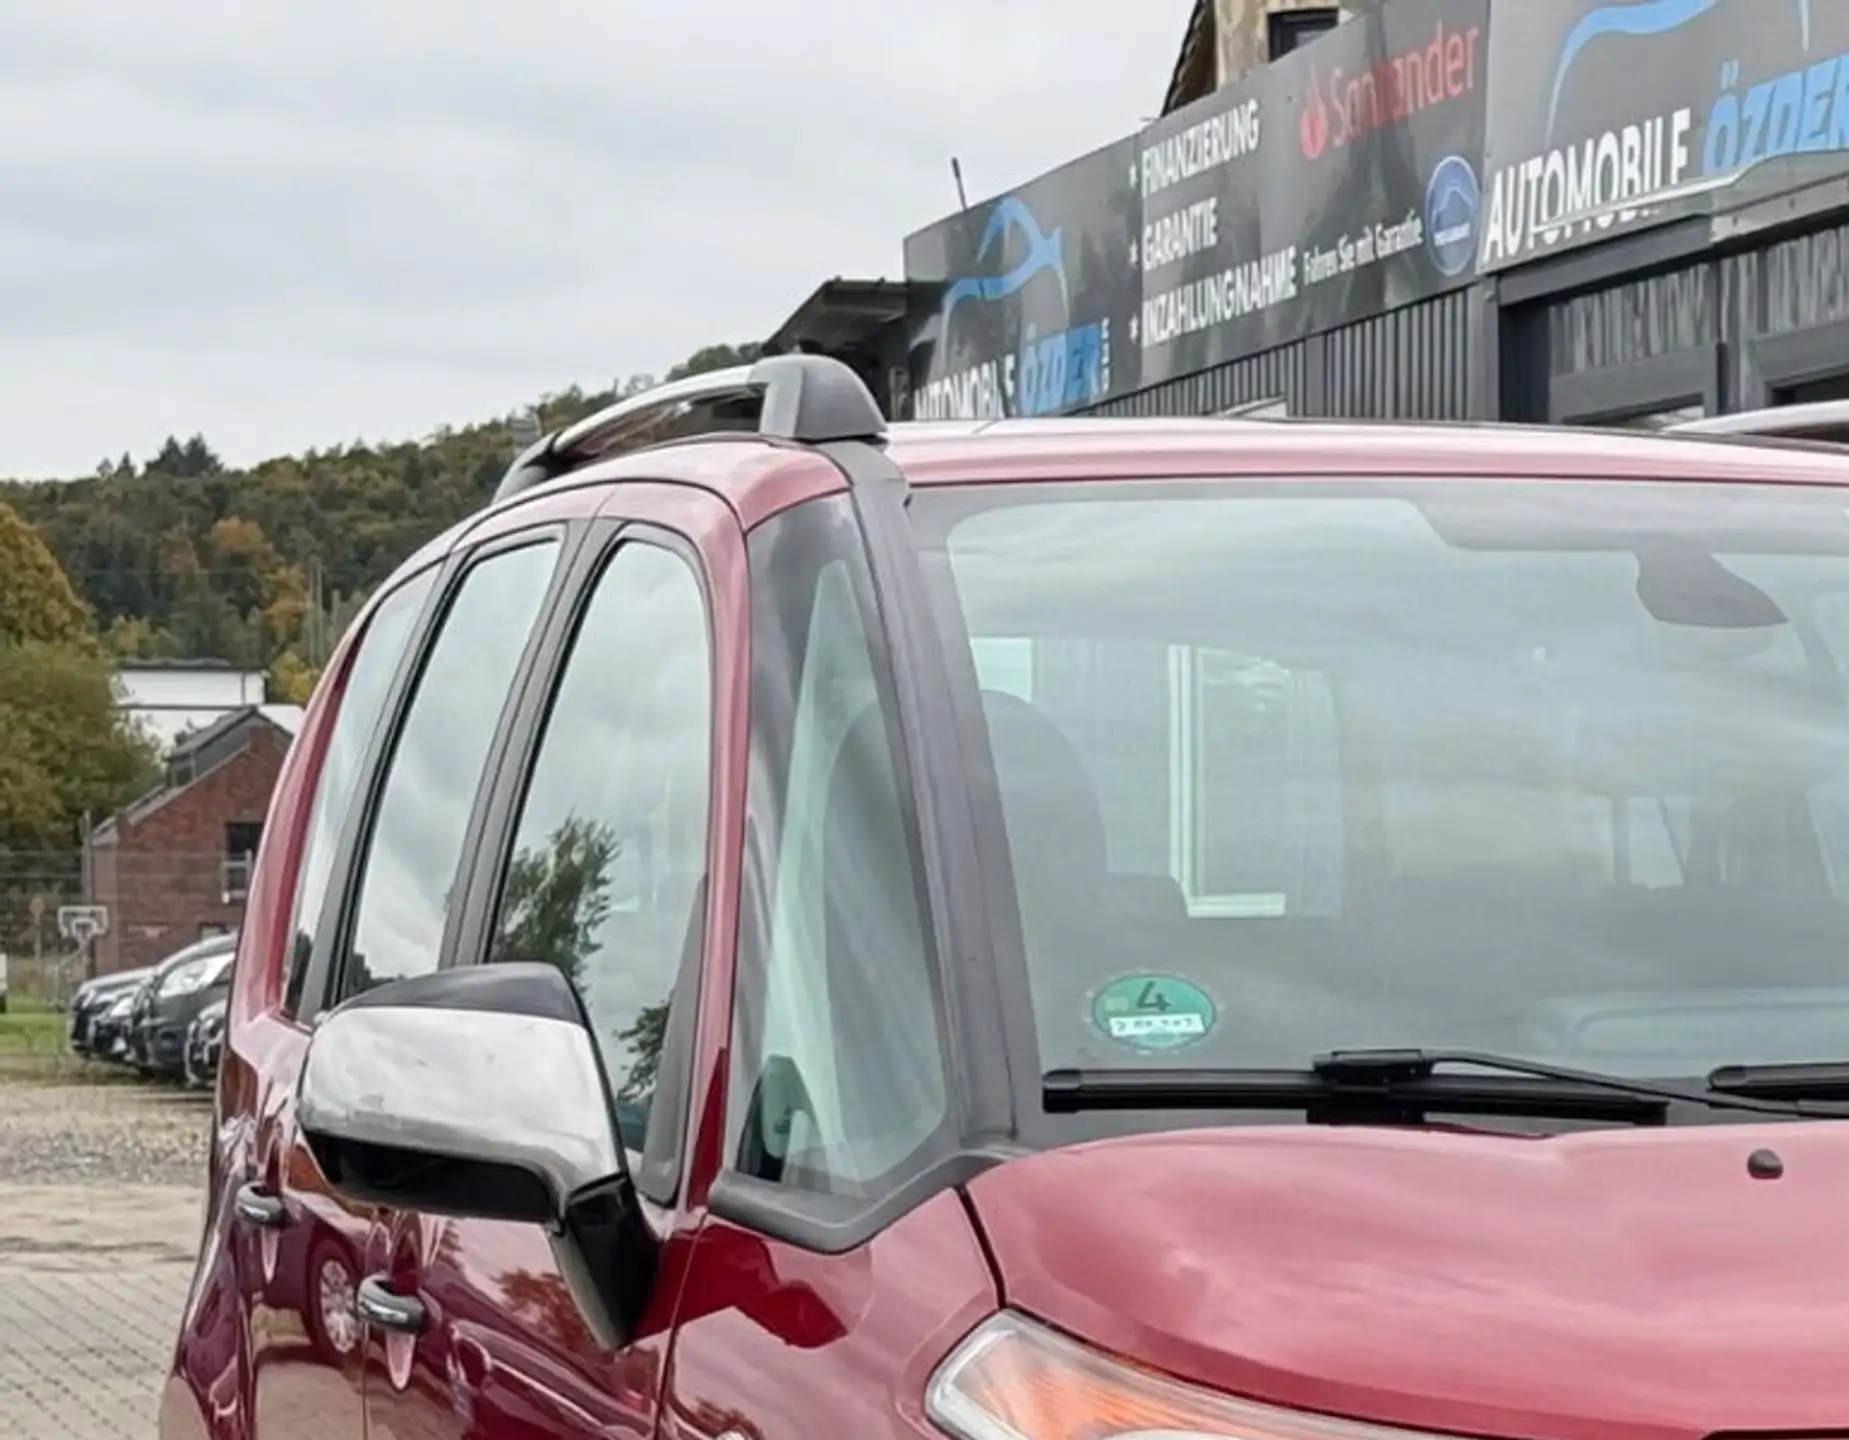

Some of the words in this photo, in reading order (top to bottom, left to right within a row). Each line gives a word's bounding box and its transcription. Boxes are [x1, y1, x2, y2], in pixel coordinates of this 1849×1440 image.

[1331, 18, 1479, 147] Sanander
[1142, 97, 1259, 199] FINANZIERUNG
[1142, 196, 1217, 271] GARANTIE
[1142, 244, 1297, 348] INZAHLUNGNAHME
[1136, 980, 1172, 1012] 4
